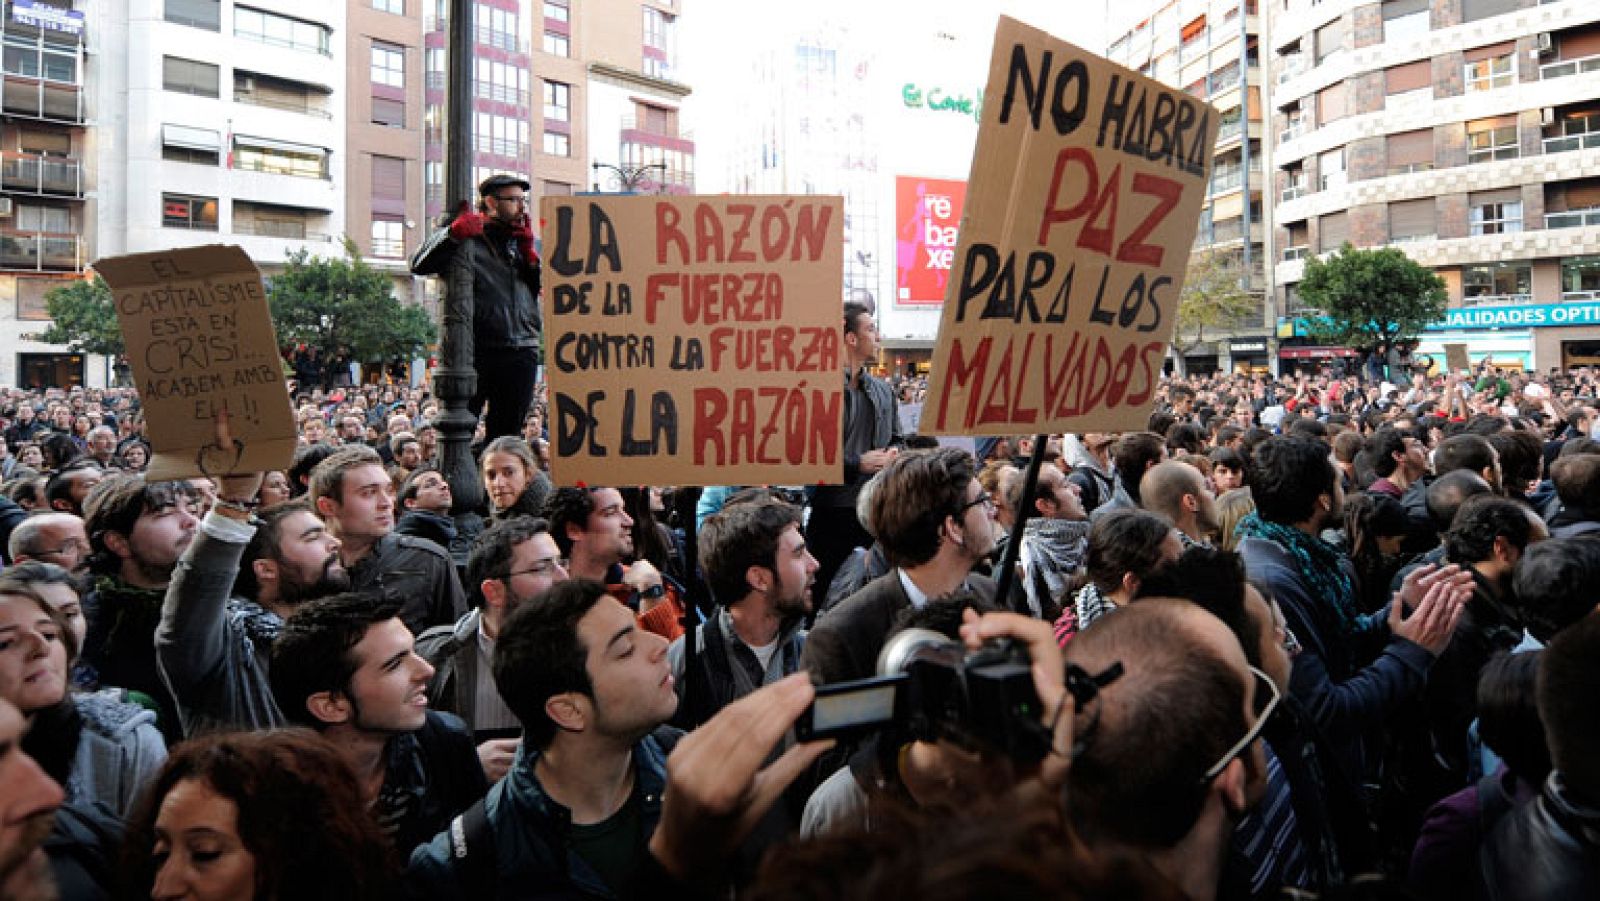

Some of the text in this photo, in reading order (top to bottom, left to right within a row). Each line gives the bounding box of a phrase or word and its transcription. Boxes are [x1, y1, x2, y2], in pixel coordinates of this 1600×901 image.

[1000, 43, 1208, 178] NO HABRA
[925, 197, 951, 218] re
[1038, 148, 1185, 267] PAZ
[550, 199, 833, 276] LA RAZÓN
[925, 219, 957, 246] ba
[151, 259, 193, 278] EL
[925, 249, 953, 269] xe
[553, 273, 783, 325] DE LA FUERZA
[956, 244, 1172, 332] PARA LOS
[210, 309, 237, 331] EN
[1427, 306, 1599, 326] IALIDADES OPTI
[554, 326, 838, 373] CONTRA LA FUERZA
[146, 364, 278, 400] ACABEM AMB
[936, 330, 1166, 431] MALVADOS
[556, 380, 841, 466] DE LA RAZÓN
